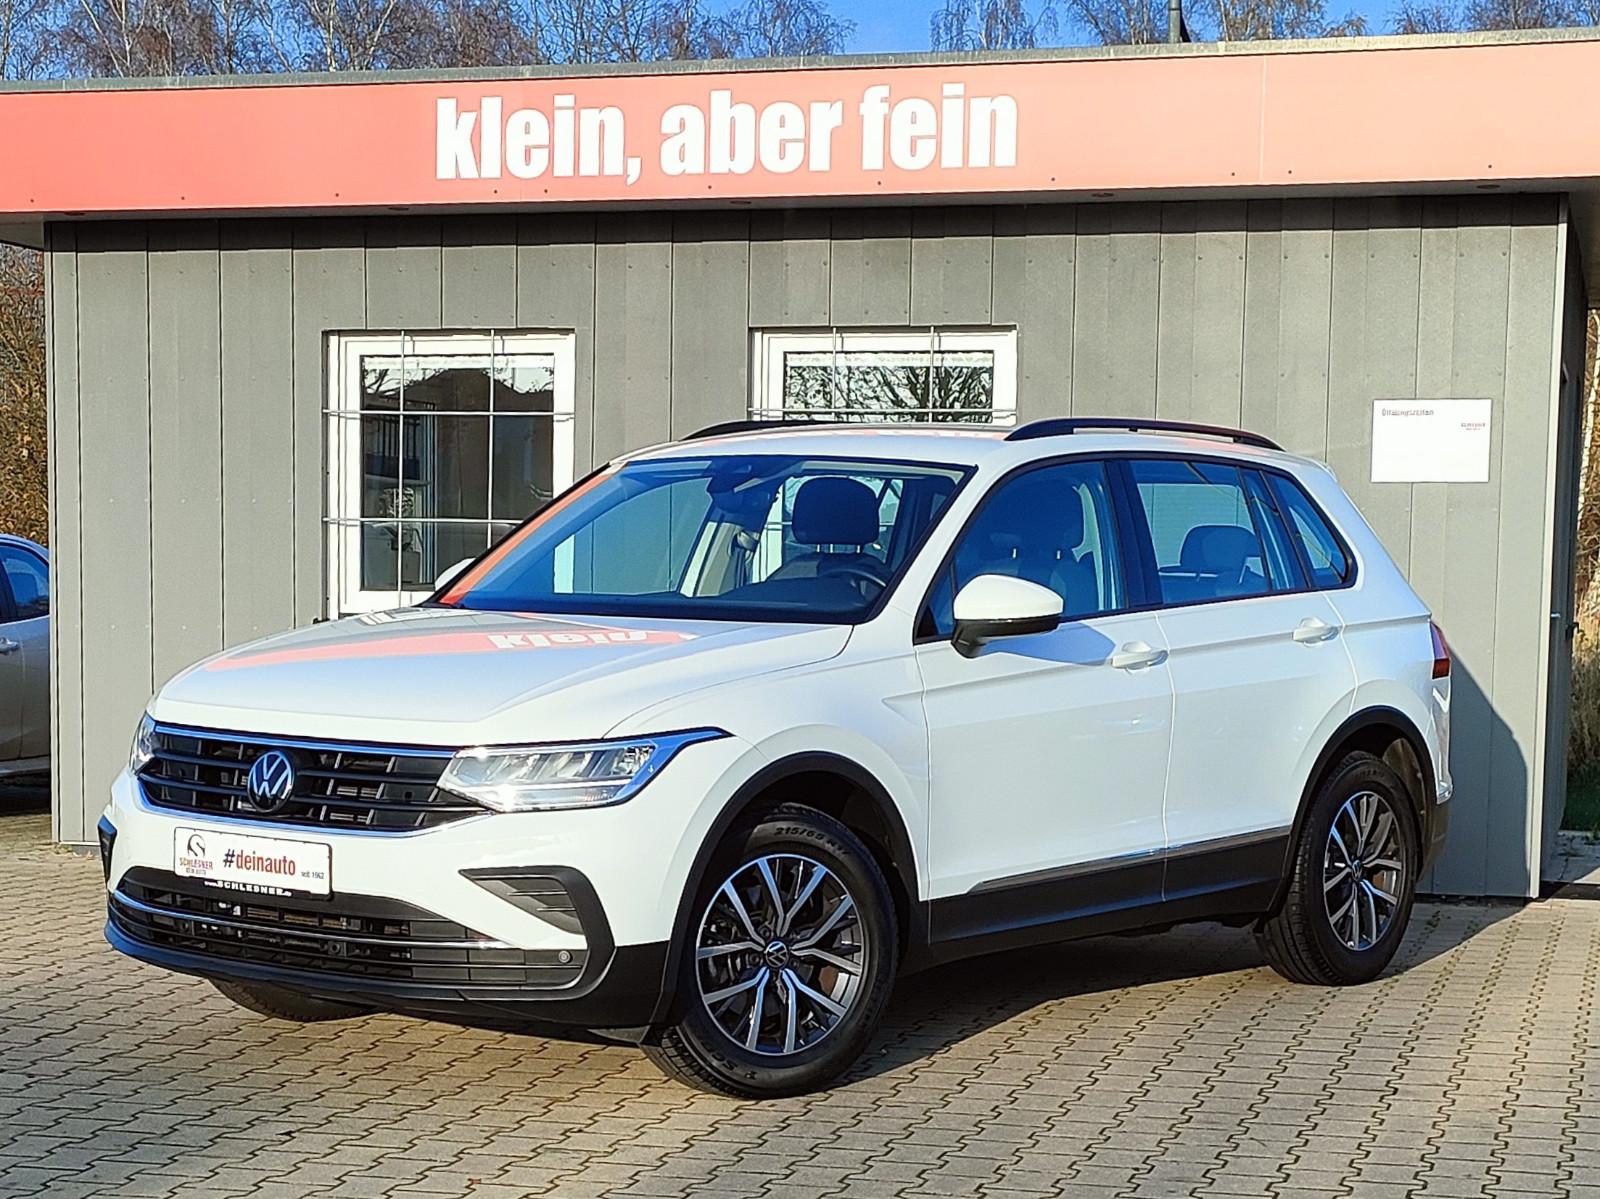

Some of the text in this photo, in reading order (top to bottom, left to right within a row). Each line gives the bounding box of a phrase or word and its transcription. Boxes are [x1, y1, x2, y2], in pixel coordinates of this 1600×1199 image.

[435, 82, 1018, 186] klein, aber fein
[222, 848, 296, 876] #deinauto
